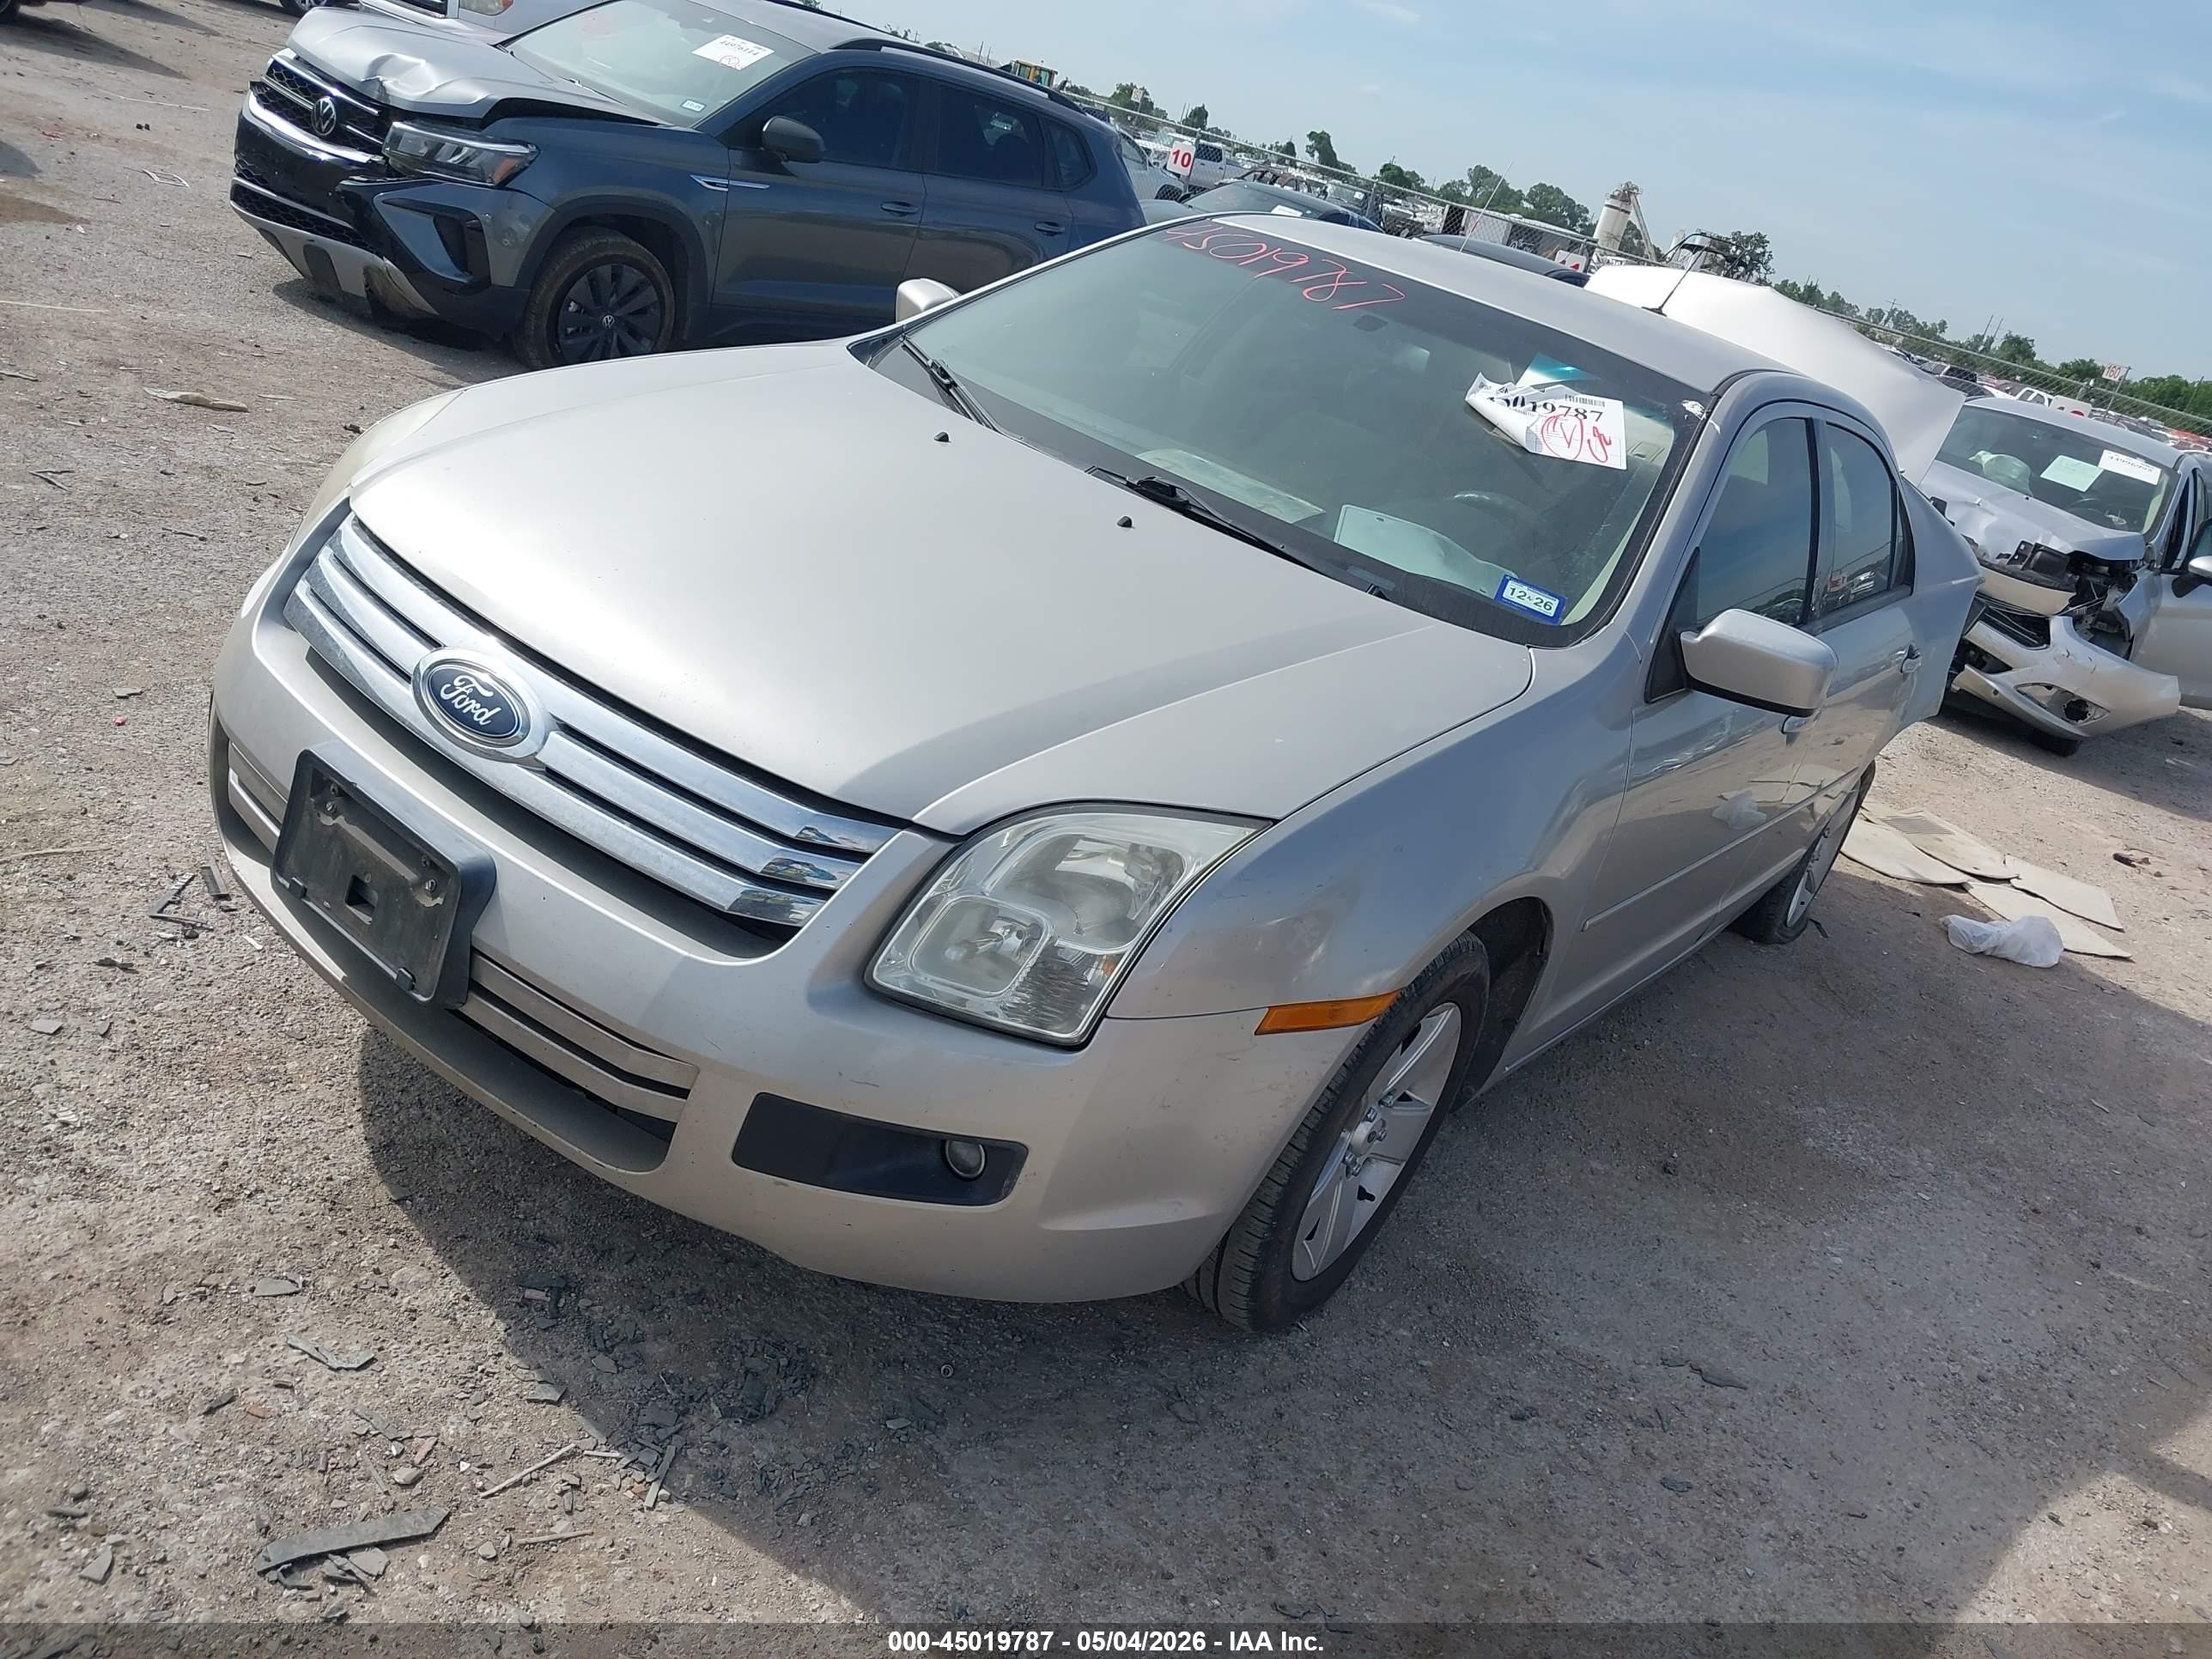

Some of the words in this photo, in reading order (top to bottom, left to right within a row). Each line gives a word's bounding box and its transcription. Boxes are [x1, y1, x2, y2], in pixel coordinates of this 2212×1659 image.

[1172, 149, 1192, 167] 10
[1164, 224, 1406, 310] 45019787
[440, 675, 501, 726] Ford
